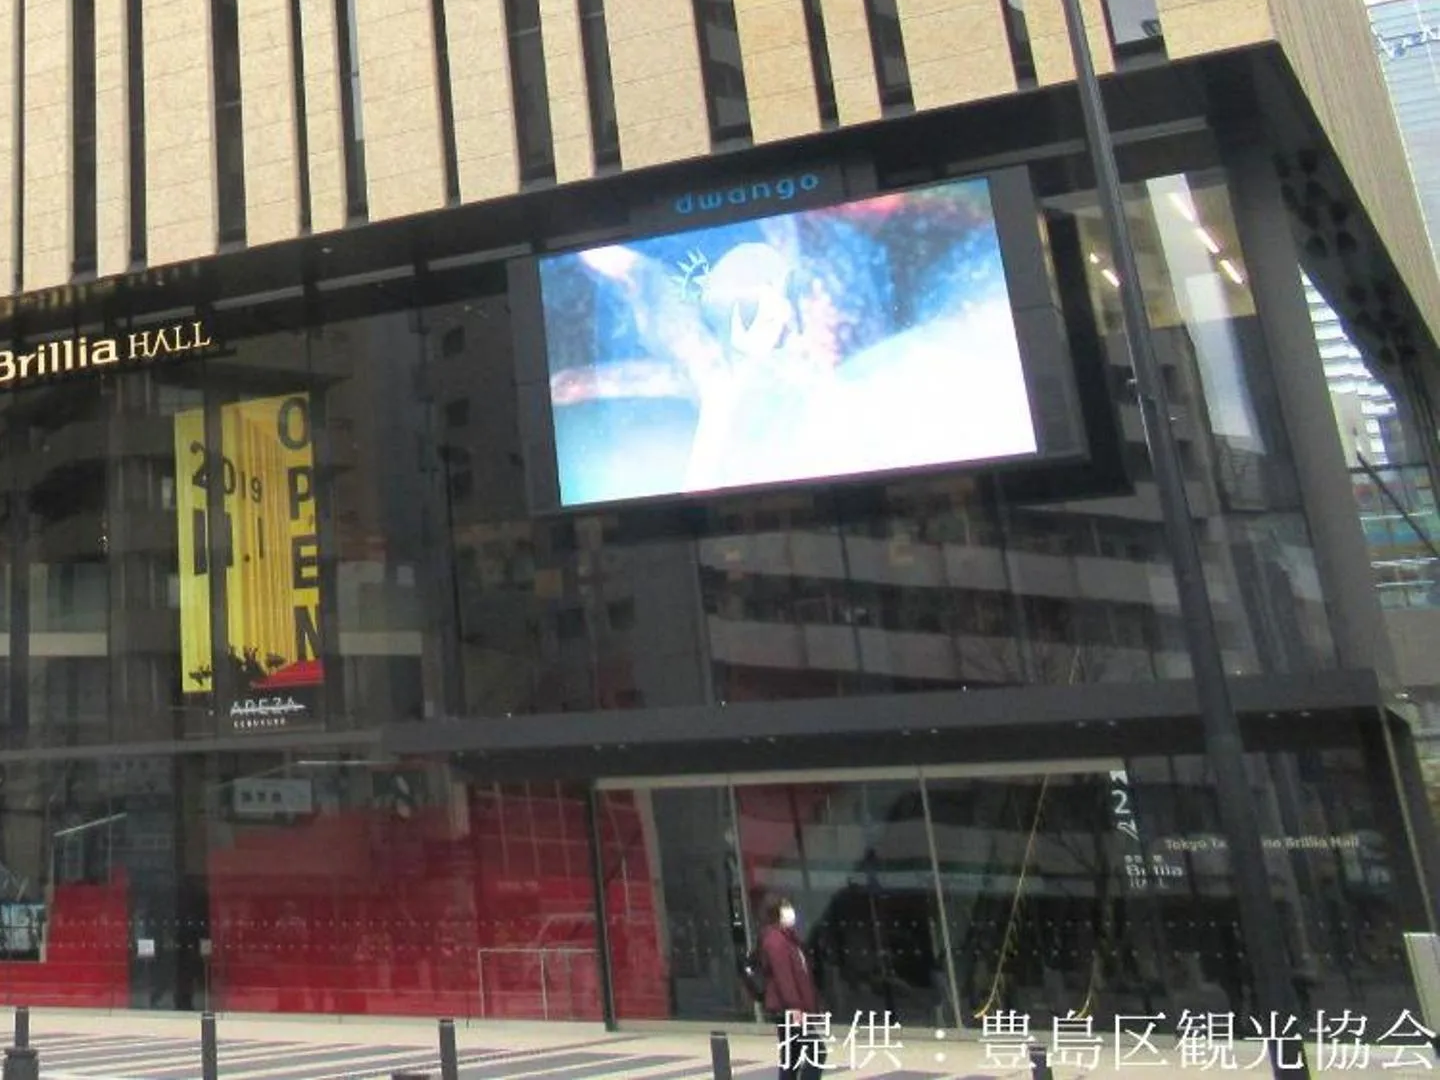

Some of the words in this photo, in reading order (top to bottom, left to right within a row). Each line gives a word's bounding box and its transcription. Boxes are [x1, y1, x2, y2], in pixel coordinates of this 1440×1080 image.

[674, 173, 819, 214] dwango
[127, 321, 211, 359] HALL
[277, 395, 321, 663] OPEN
